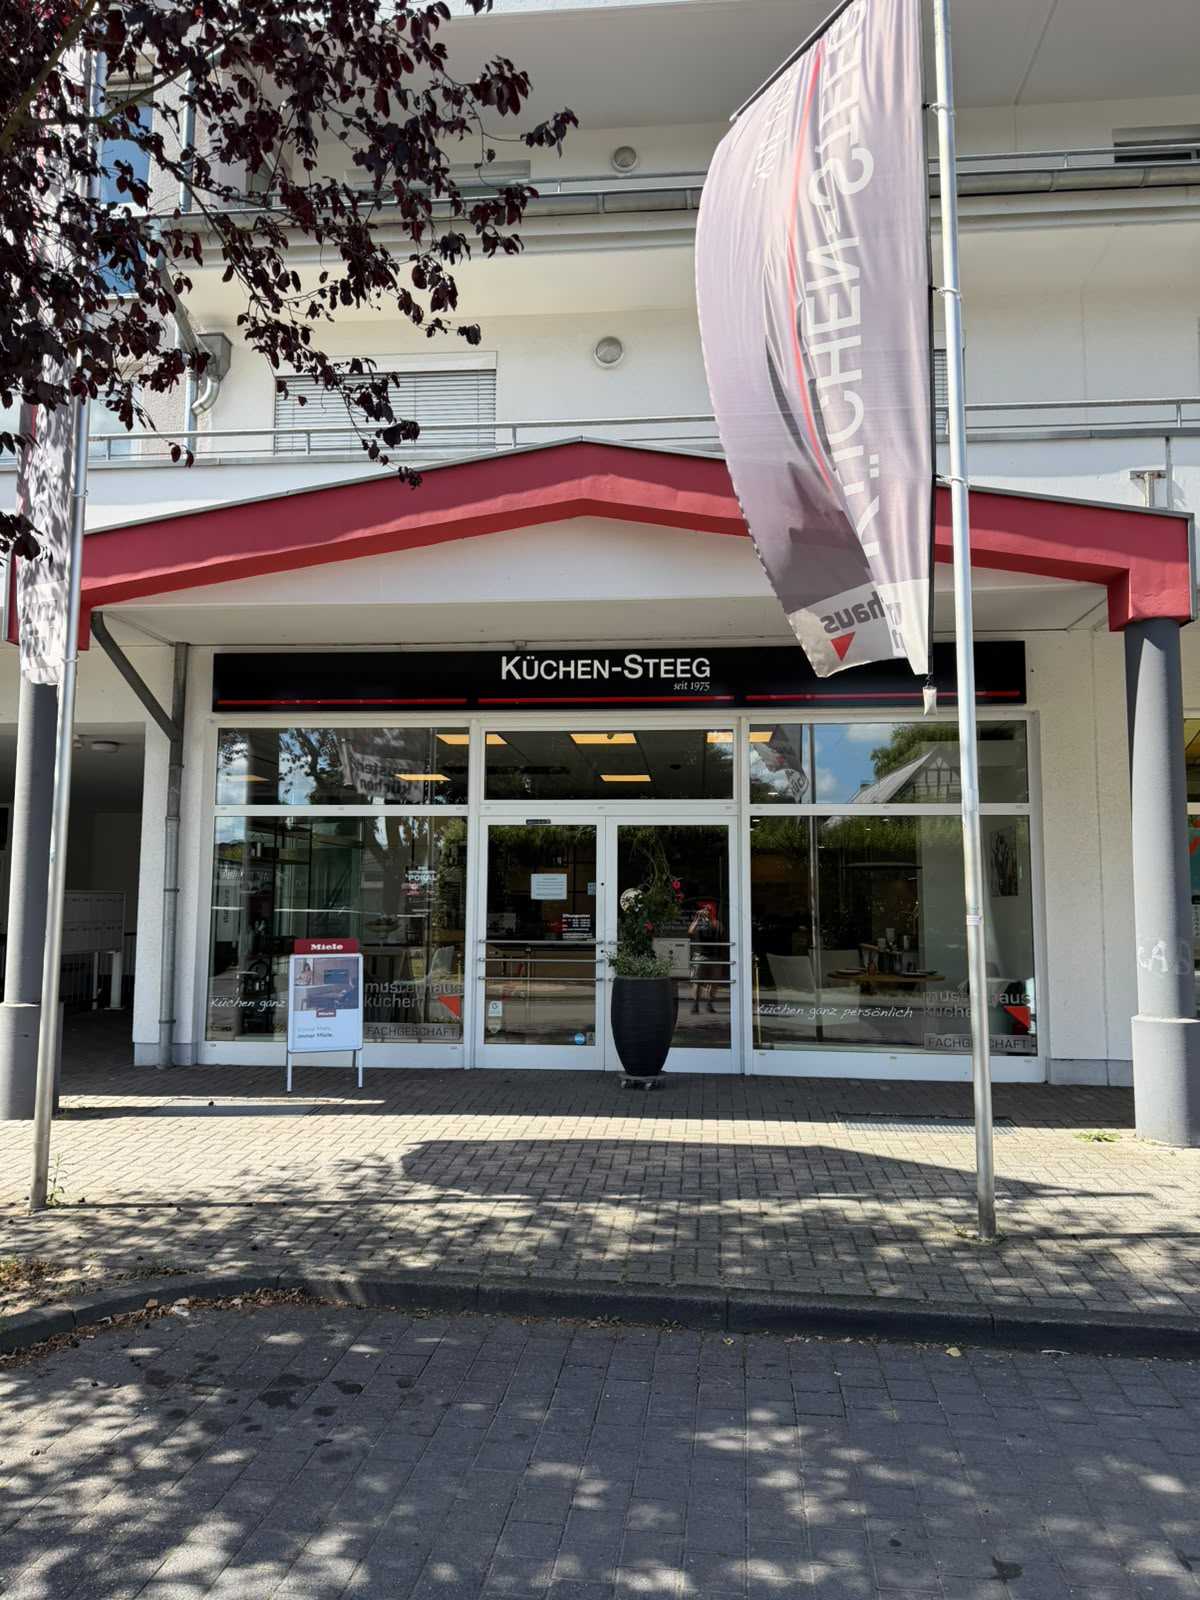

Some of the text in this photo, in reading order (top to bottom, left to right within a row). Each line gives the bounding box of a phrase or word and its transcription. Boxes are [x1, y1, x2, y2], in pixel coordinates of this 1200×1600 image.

[501, 653, 711, 681] KÜCHEN-STEEG
[673, 681, 711, 691] seit 1975
[310, 943, 344, 952] Miele
[257, 999, 288, 1013] ganz
[363, 993, 424, 1009] küchen
[807, 1006, 838, 1021] ganz
[839, 1006, 914, 1020] persönlich
[922, 1004, 972, 1018] küche
